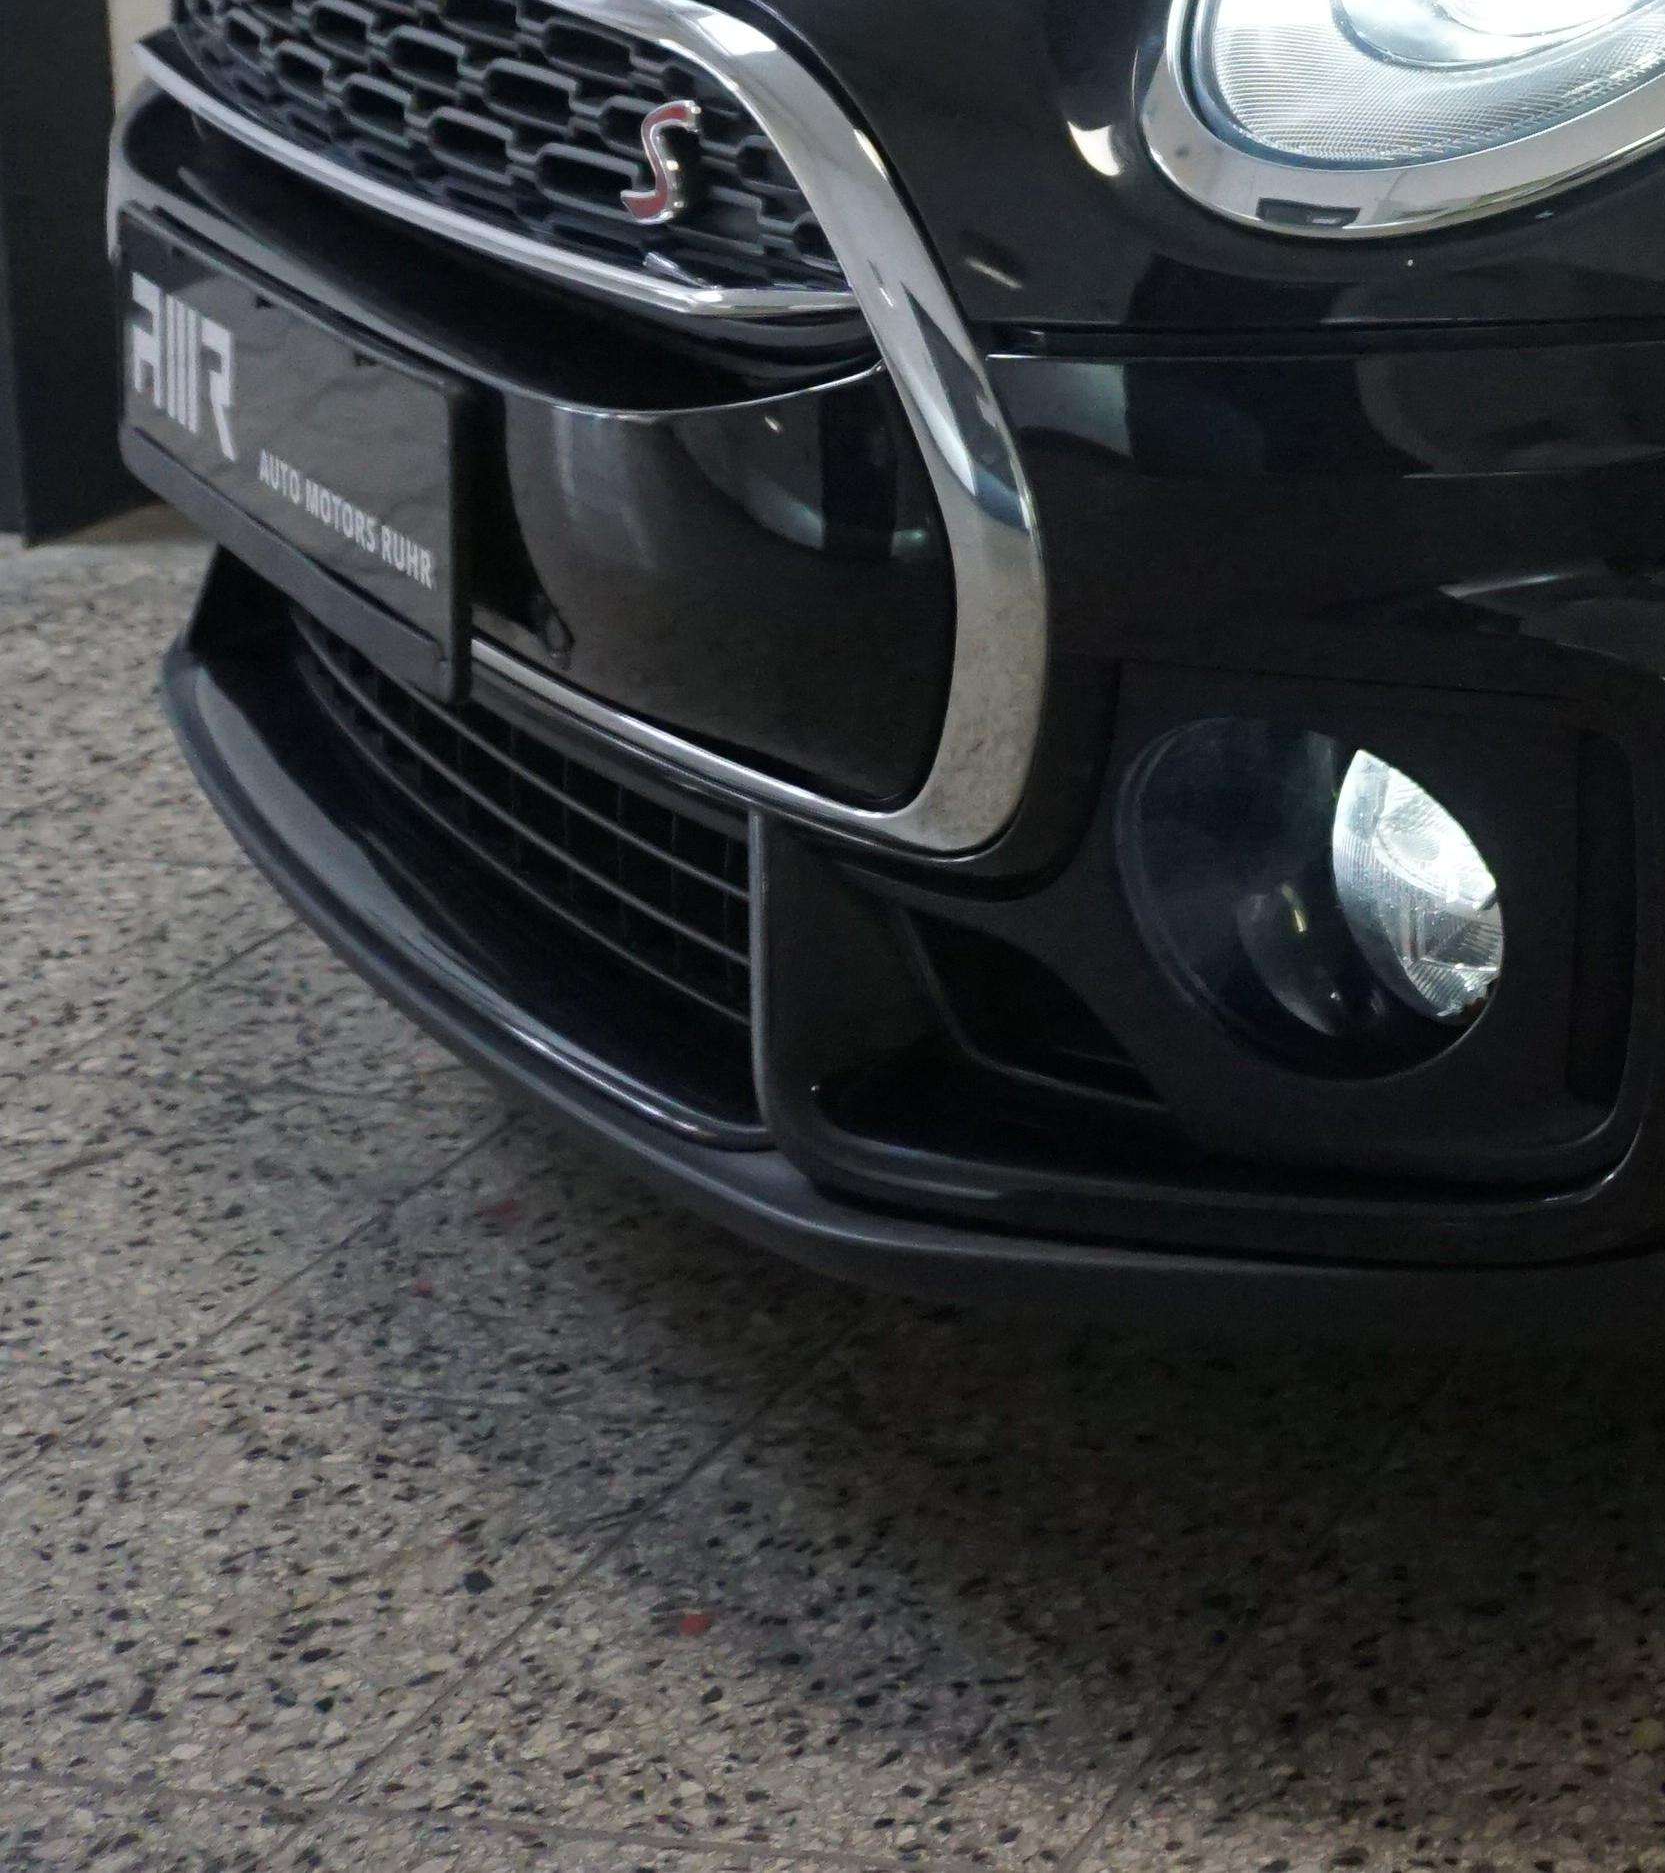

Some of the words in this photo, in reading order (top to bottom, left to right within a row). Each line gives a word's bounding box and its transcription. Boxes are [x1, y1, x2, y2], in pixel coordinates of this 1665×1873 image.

[620, 99, 702, 225] S
[259, 448, 301, 505] AUTO
[305, 478, 376, 554] MOTORS
[381, 525, 433, 590] RUHR
